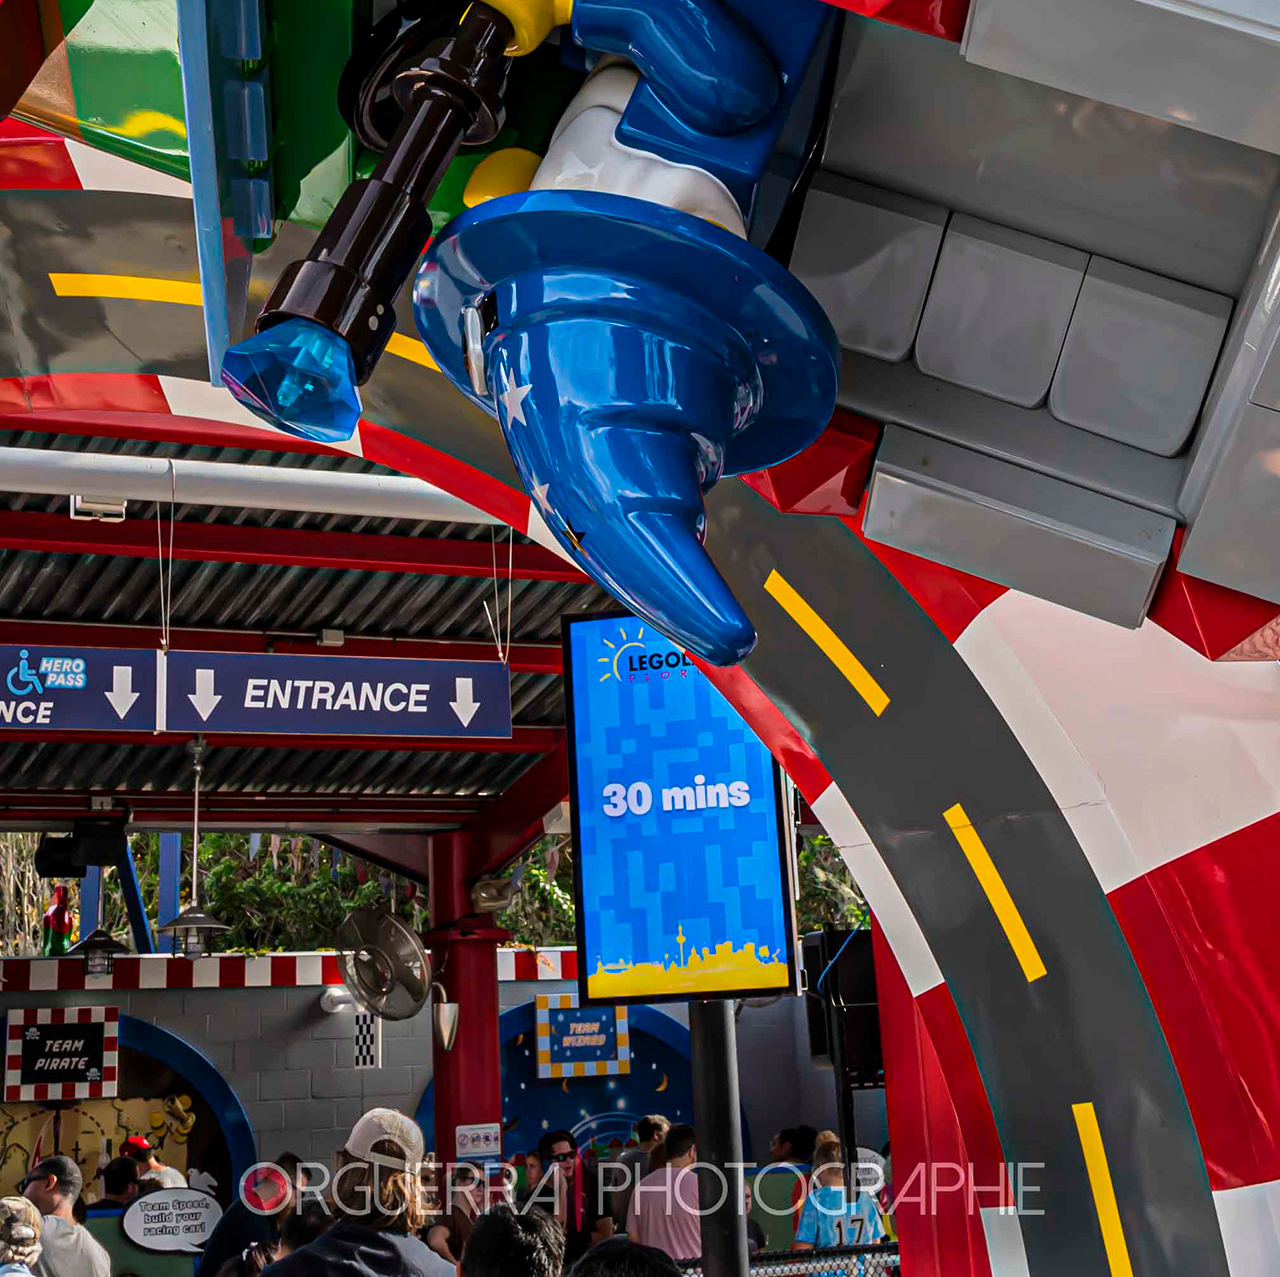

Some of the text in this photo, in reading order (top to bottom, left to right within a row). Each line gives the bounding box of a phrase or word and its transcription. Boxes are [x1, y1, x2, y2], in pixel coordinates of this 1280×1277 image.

[40, 659, 84, 673] HERO
[628, 651, 694, 672] LEGOL
[47, 673, 85, 687] PASS
[629, 669, 702, 683] FLOR
[243, 678, 430, 713] ENTRANCE
[602, 774, 751, 817] 30 mins
[569, 1022, 600, 1035] TEAM
[45, 1039, 84, 1052] TEAM
[34, 1057, 89, 1070] PIRATE
[139, 1198, 210, 1212] Team Speed,
[144, 1211, 202, 1224] build your
[143, 1225, 180, 1236] racing
[834, 1217, 866, 1245] 17
